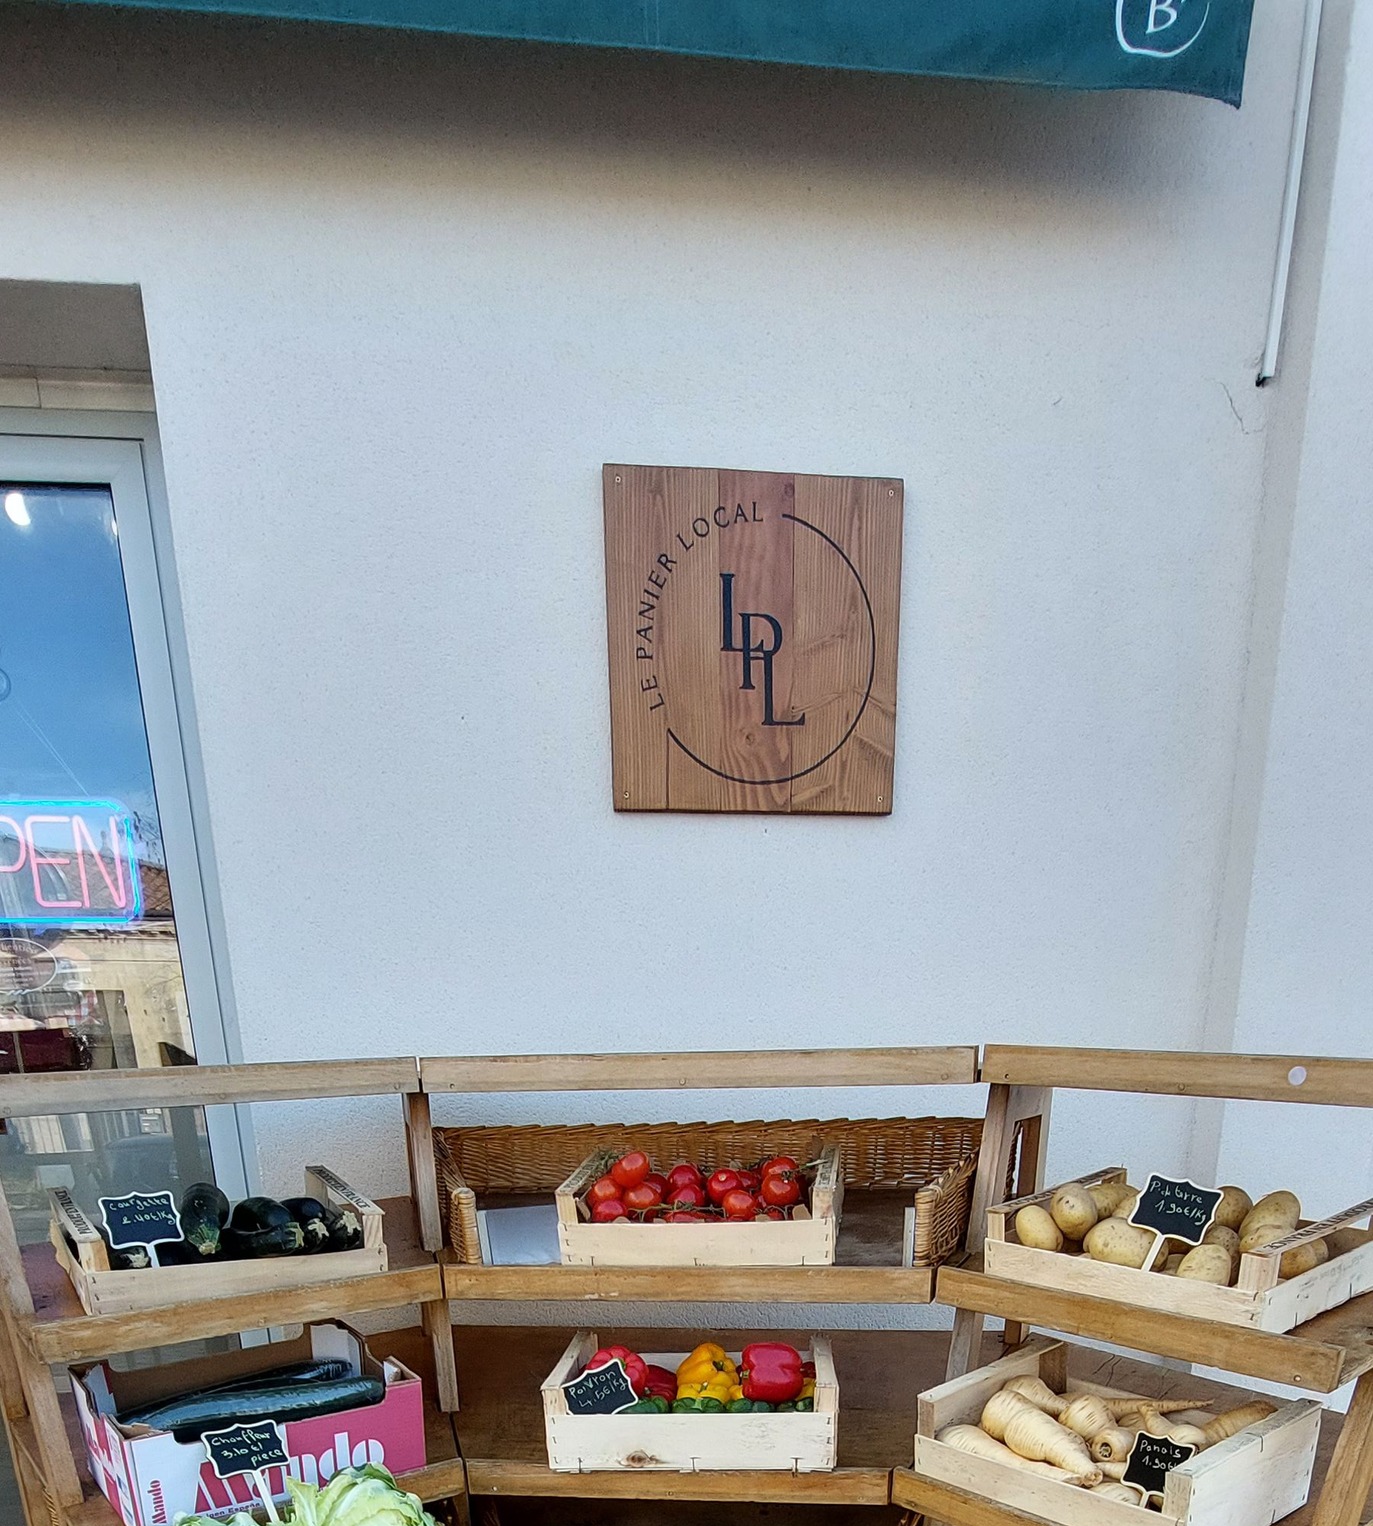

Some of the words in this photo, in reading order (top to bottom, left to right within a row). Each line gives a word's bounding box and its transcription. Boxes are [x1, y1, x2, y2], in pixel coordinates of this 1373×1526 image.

[676, 501, 764, 551] LOCAL
[636, 552, 677, 661] PANIER
[640, 675, 665, 712] LE
[568, 1371, 616, 1399] Poivron
[1139, 1440, 1181, 1458] Panais
[147, 1480, 167, 1524] Mando
